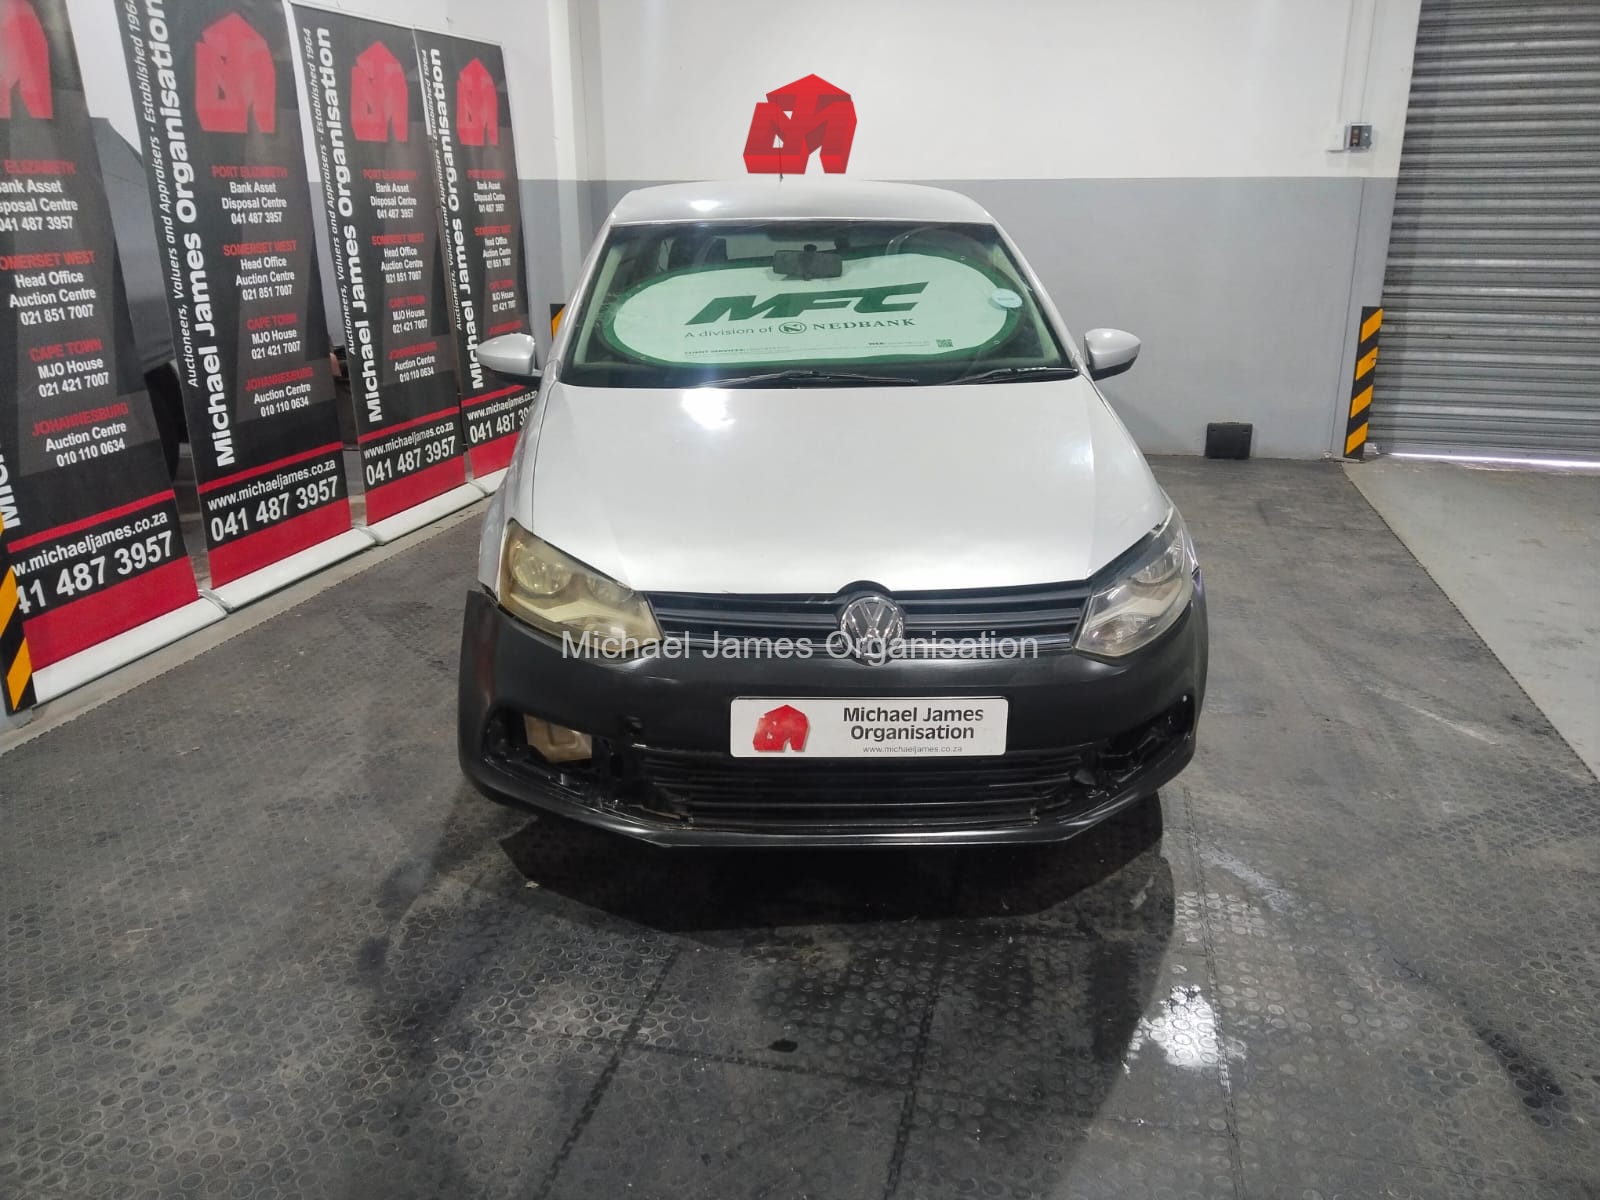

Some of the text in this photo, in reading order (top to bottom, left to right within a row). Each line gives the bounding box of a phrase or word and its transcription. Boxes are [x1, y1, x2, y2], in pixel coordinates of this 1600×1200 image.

[130, 35, 156, 123] Established
[151, 136, 172, 213] Appraisers
[0, 179, 63, 193] ank Asset
[229, 181, 276, 194] Bank Asset
[303, 27, 356, 355] Auctioneers, Valuers and Appraisers Established 1964
[40, 198, 78, 211] Centre
[221, 196, 287, 211] Disposal Centre
[22, 216, 43, 230] 487
[46, 215, 73, 229] 3957
[230, 211, 282, 224] 041 487 3957
[316, 27, 383, 423] Michael James Organisation
[430, 48, 484, 389] Michael James Organisation
[145, 0, 235, 467] Michael James Organisation
[160, 215, 176, 244] and
[240, 256, 287, 270] Head Office
[383, 247, 399, 258] Head
[14, 270, 84, 288] Head Office
[168, 247, 184, 299] Valuers
[235, 270, 295, 286] Auction Centre
[9, 288, 96, 308] Auction Centre
[242, 284, 293, 301] 021 851 7007
[685, 281, 930, 325] MFC
[20, 303, 94, 326] 021 851 7007
[405, 308, 425, 319] House
[251, 329, 297, 344] MJO House
[699, 327, 754, 338] division
[759, 325, 773, 334] of
[812, 318, 917, 330] NEDBANK
[177, 304, 199, 388] Auctioneers,
[251, 341, 301, 360] 021 421 7007
[37, 358, 104, 379] MJO House
[38, 371, 109, 398] 021 421 7007
[253, 383, 311, 404] Auction Centre
[260, 396, 309, 417] 010 110 0634
[45, 422, 127, 452] Auction Centre
[469, 420, 493, 443] 041
[496, 412, 515, 434] 487
[363, 421, 454, 460] www.michaeljames.co.za
[56, 437, 126, 467] 010 110 0634
[366, 435, 456, 486] 041 487 3957
[207, 459, 336, 511] www.michaeljames.co.za
[211, 475, 338, 541] 041 487 3957
[56, 556, 105, 596] 487
[114, 530, 172, 575] 3957
[843, 707, 984, 722] Michael James
[850, 725, 975, 742] Organisation
[862, 745, 962, 755] www.michaeljames.co.za
